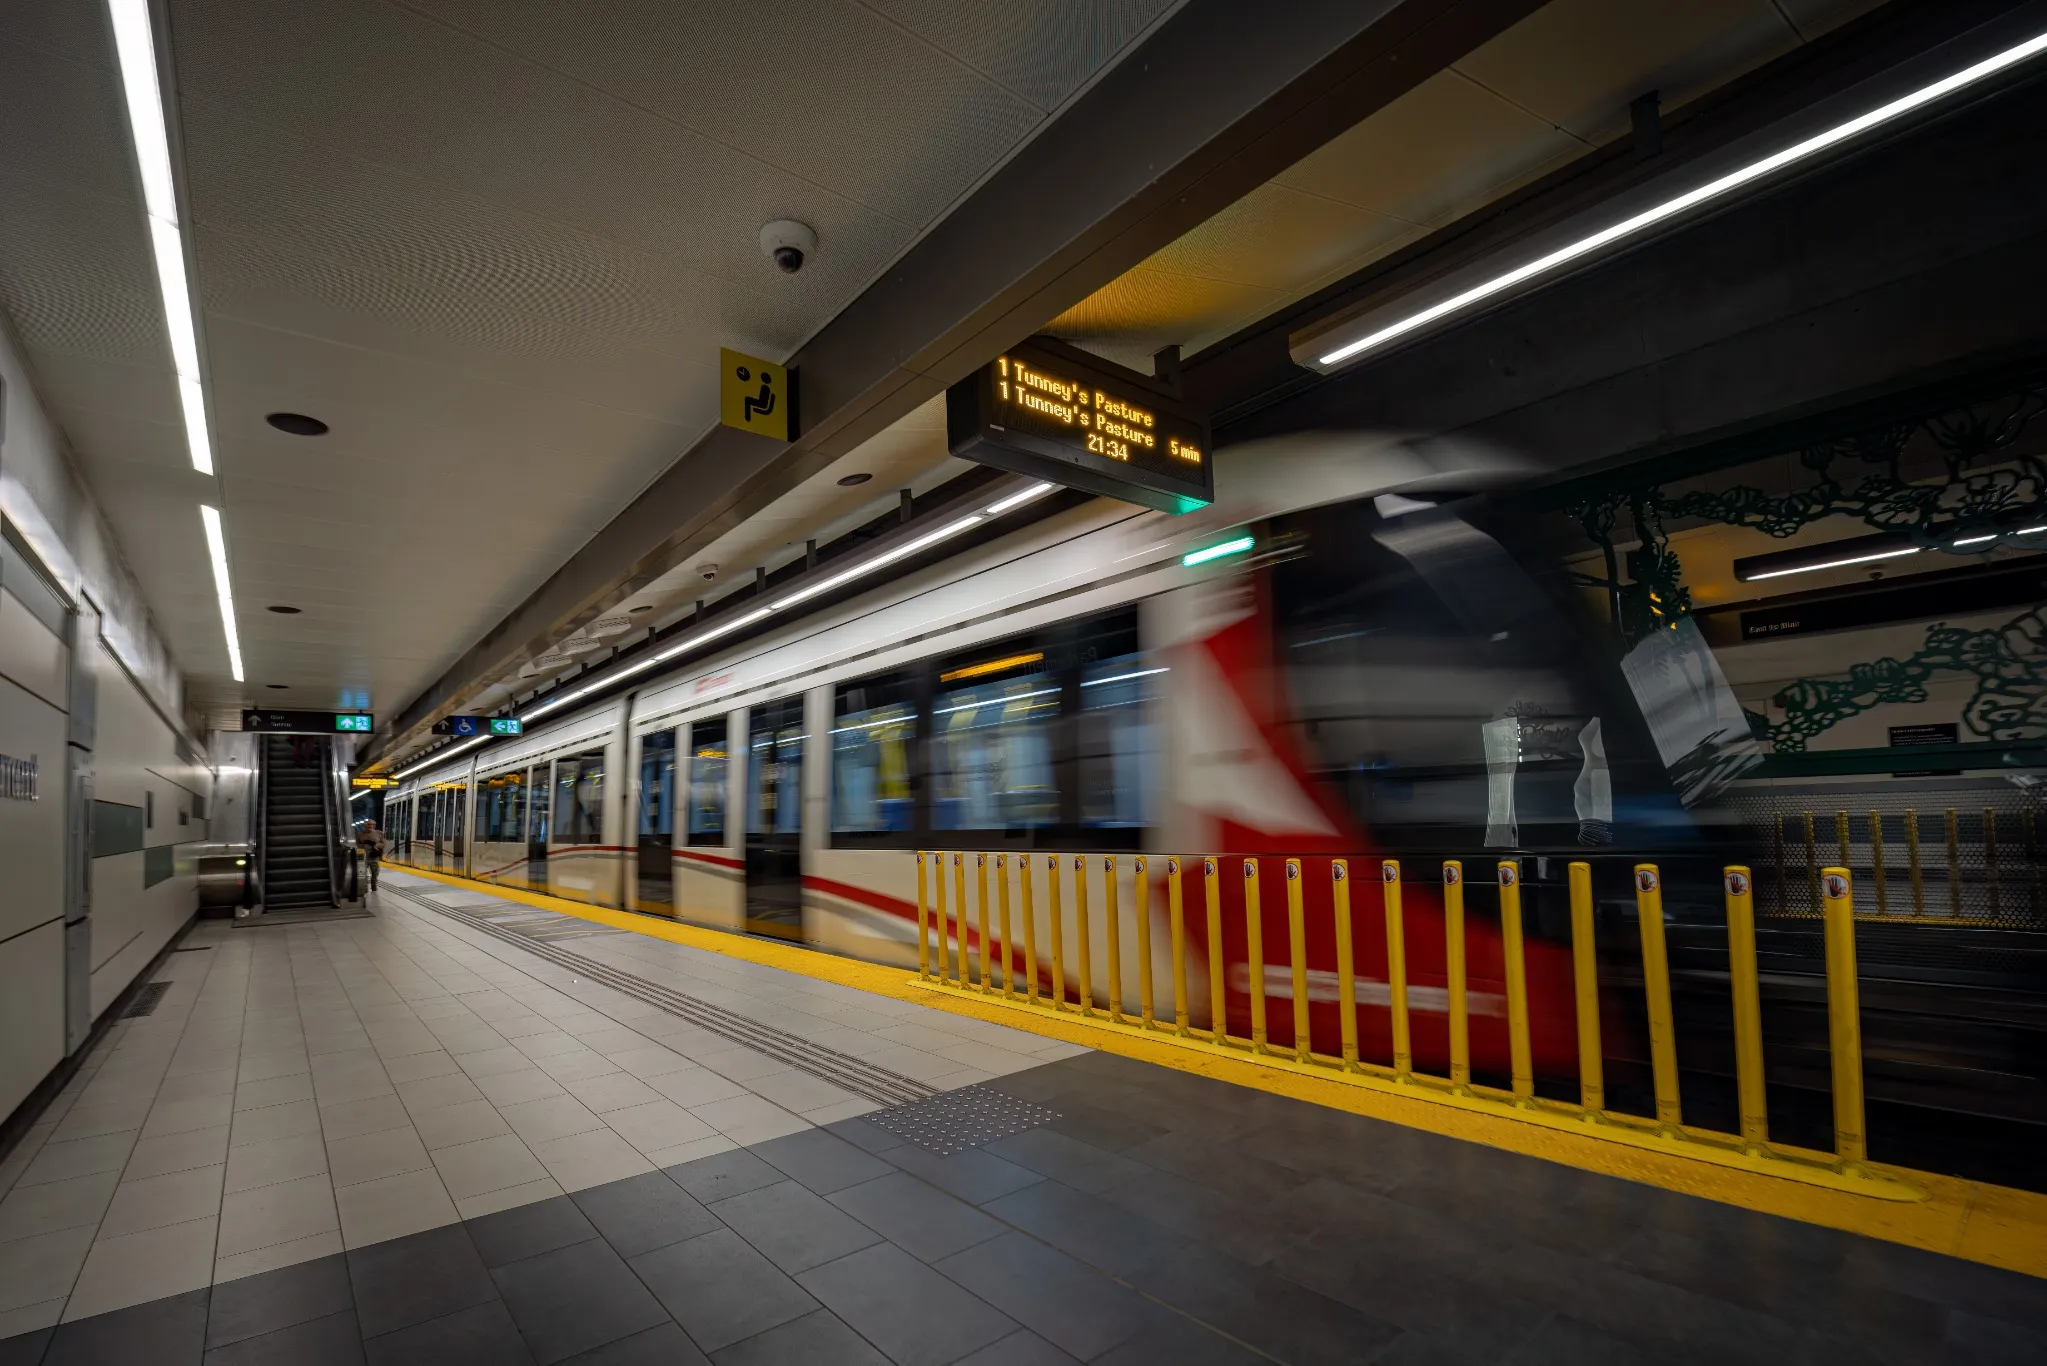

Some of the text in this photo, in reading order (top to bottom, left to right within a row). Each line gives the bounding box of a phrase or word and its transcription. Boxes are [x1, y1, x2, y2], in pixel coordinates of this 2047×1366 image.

[999, 358, 1153, 427] 1 Tunney's Pasture
[1000, 381, 1200, 463] 1 Tunney's Pasture 5 min
[1088, 433, 1128, 461] 21:34
